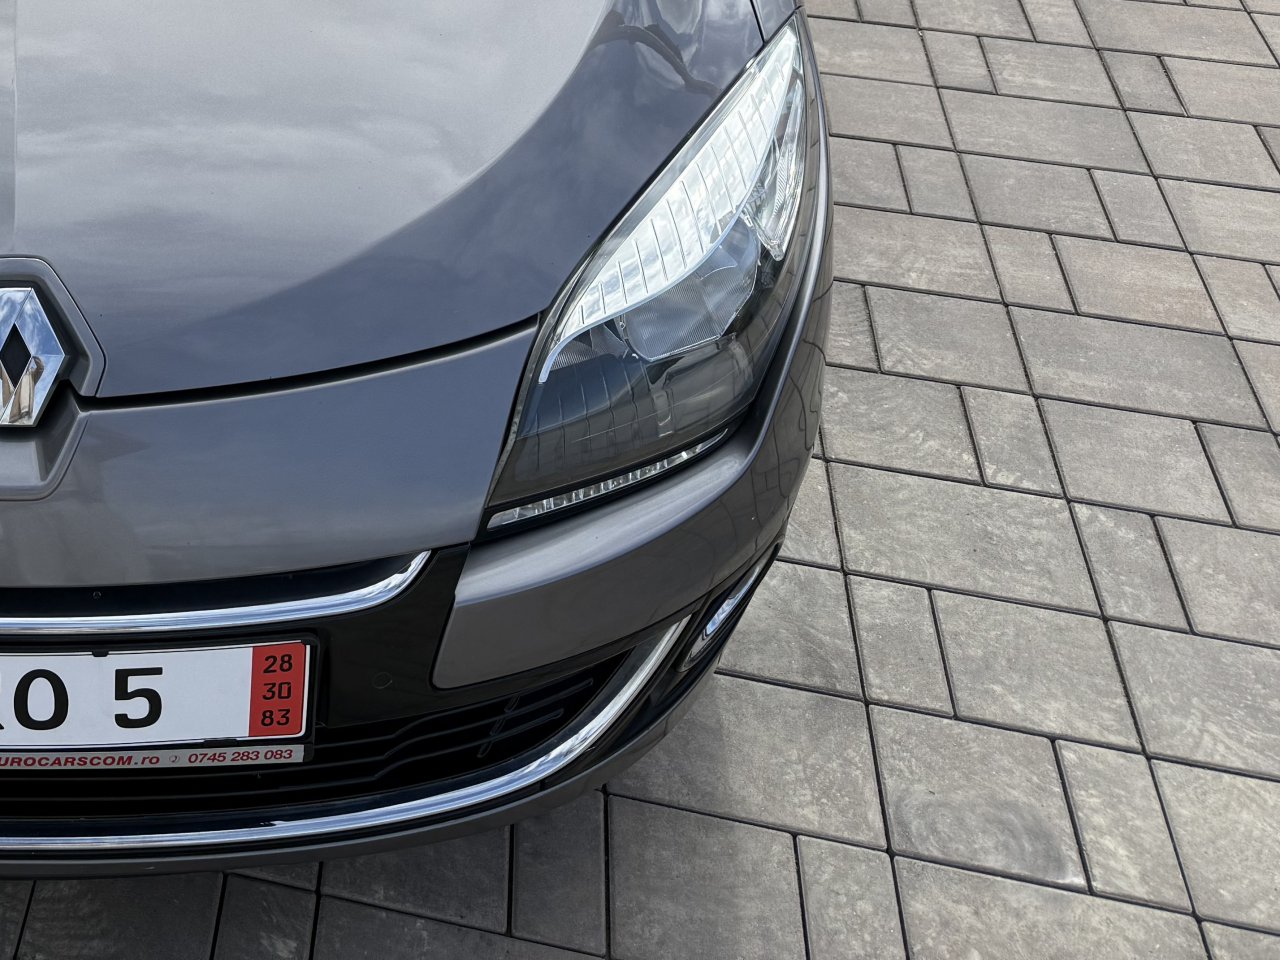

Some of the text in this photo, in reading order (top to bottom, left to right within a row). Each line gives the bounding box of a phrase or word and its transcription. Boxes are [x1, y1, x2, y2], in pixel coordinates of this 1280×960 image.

[263, 654, 293, 674] 28
[115, 667, 163, 728] 5
[262, 682, 292, 701] 30
[261, 709, 291, 727] 83
[188, 752, 227, 764] 0745
[230, 751, 260, 762] 283
[263, 749, 293, 761] 083
